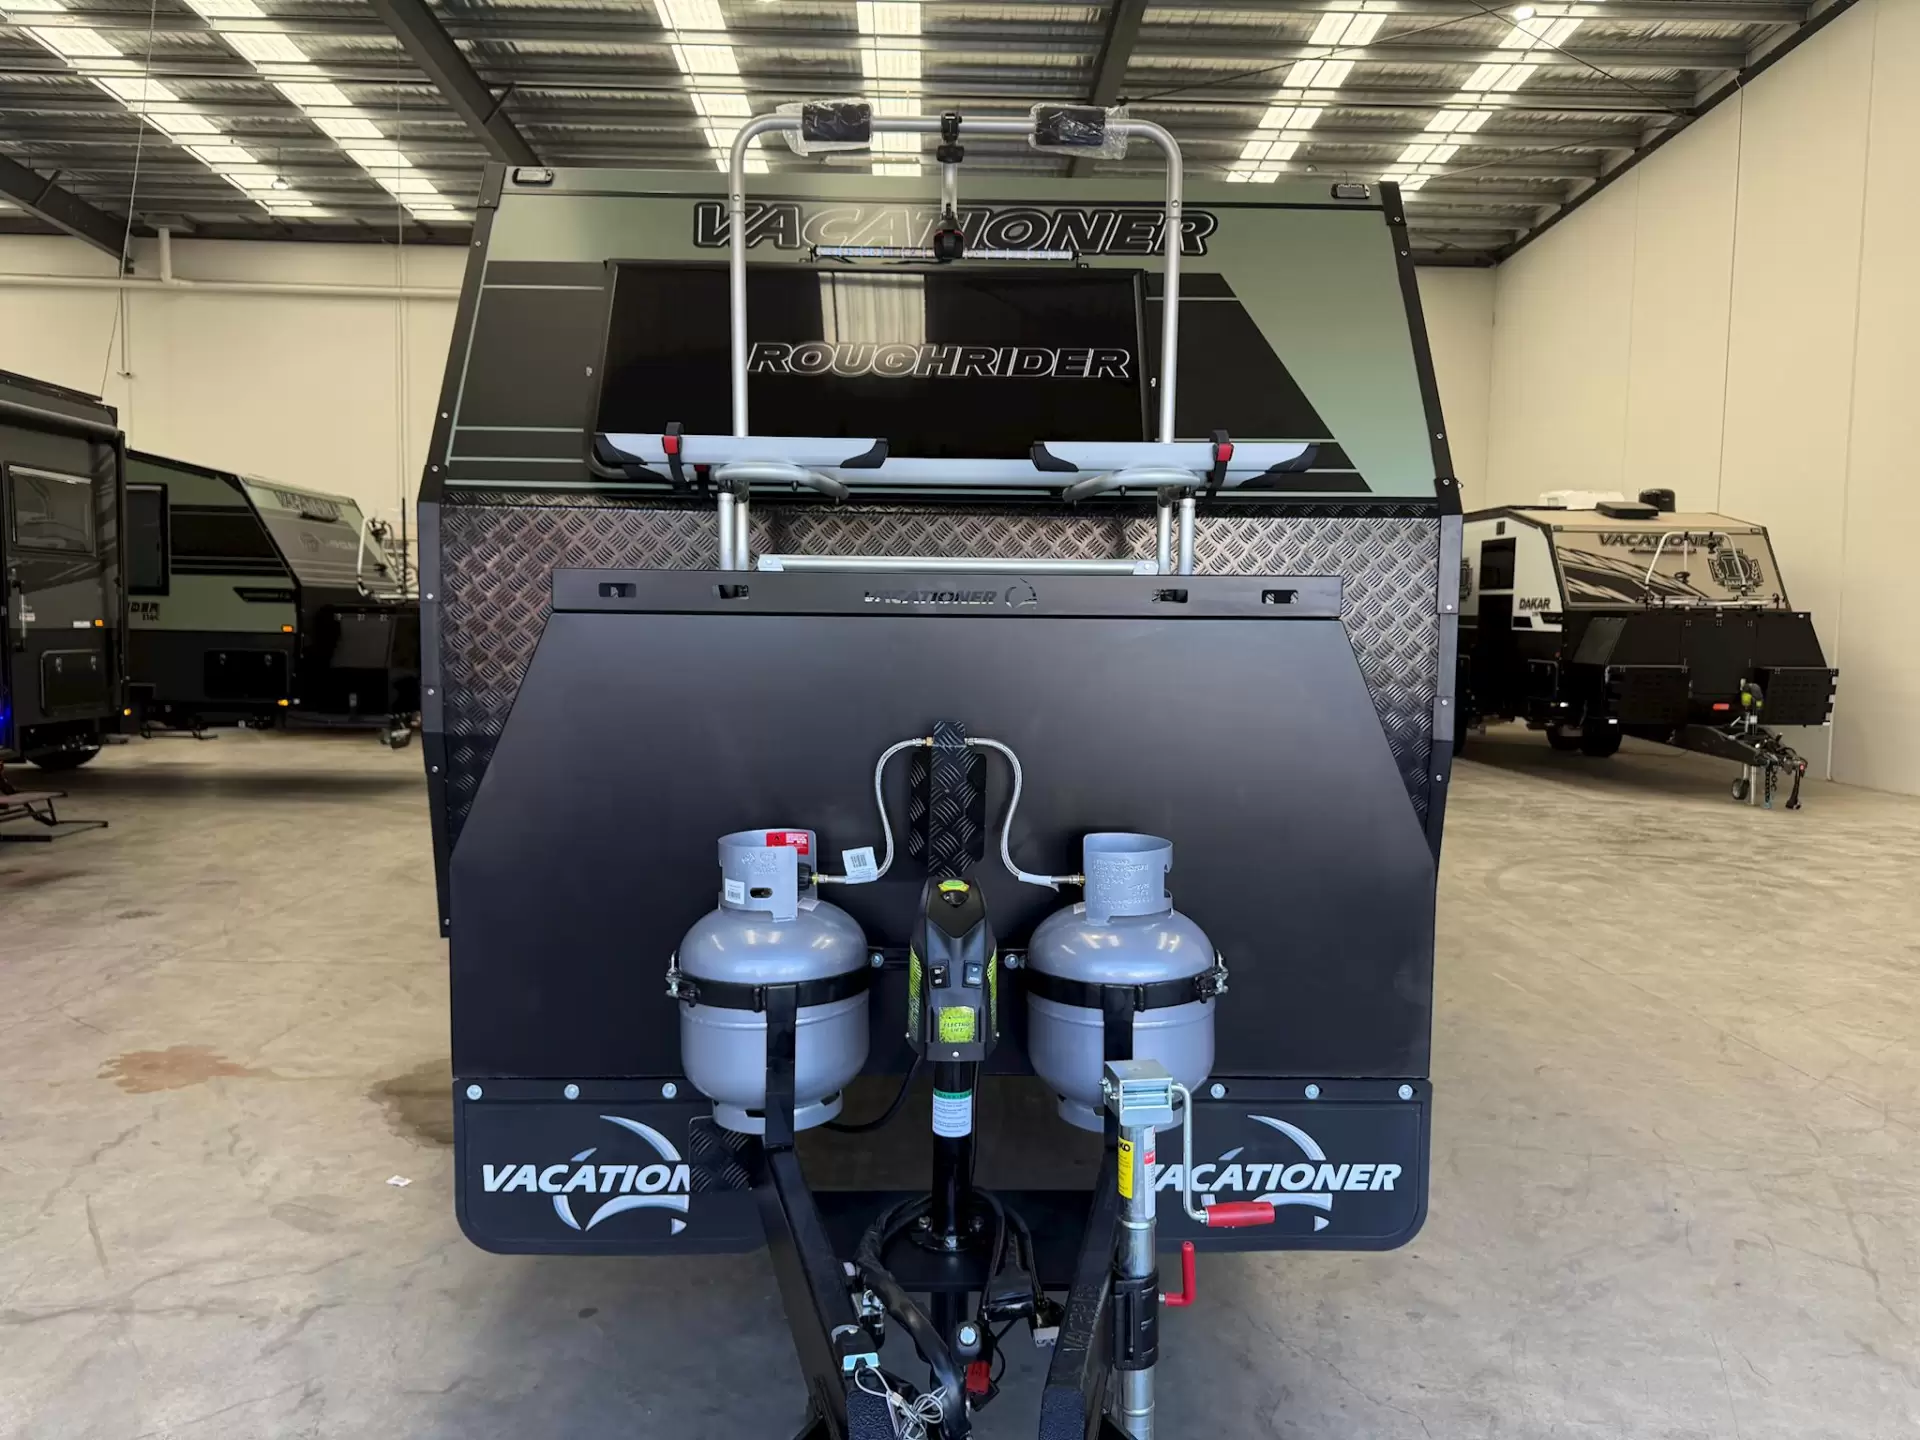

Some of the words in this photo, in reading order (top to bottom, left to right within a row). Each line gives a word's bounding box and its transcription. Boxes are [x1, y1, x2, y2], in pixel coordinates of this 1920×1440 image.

[693, 202, 1219, 256] VACATIONER
[746, 341, 1131, 379] ROUGHRIDER
[1519, 598, 1551, 610] DAKAR
[482, 1164, 691, 1193] VACATION
[1155, 1163, 1402, 1192] ACATIONER
